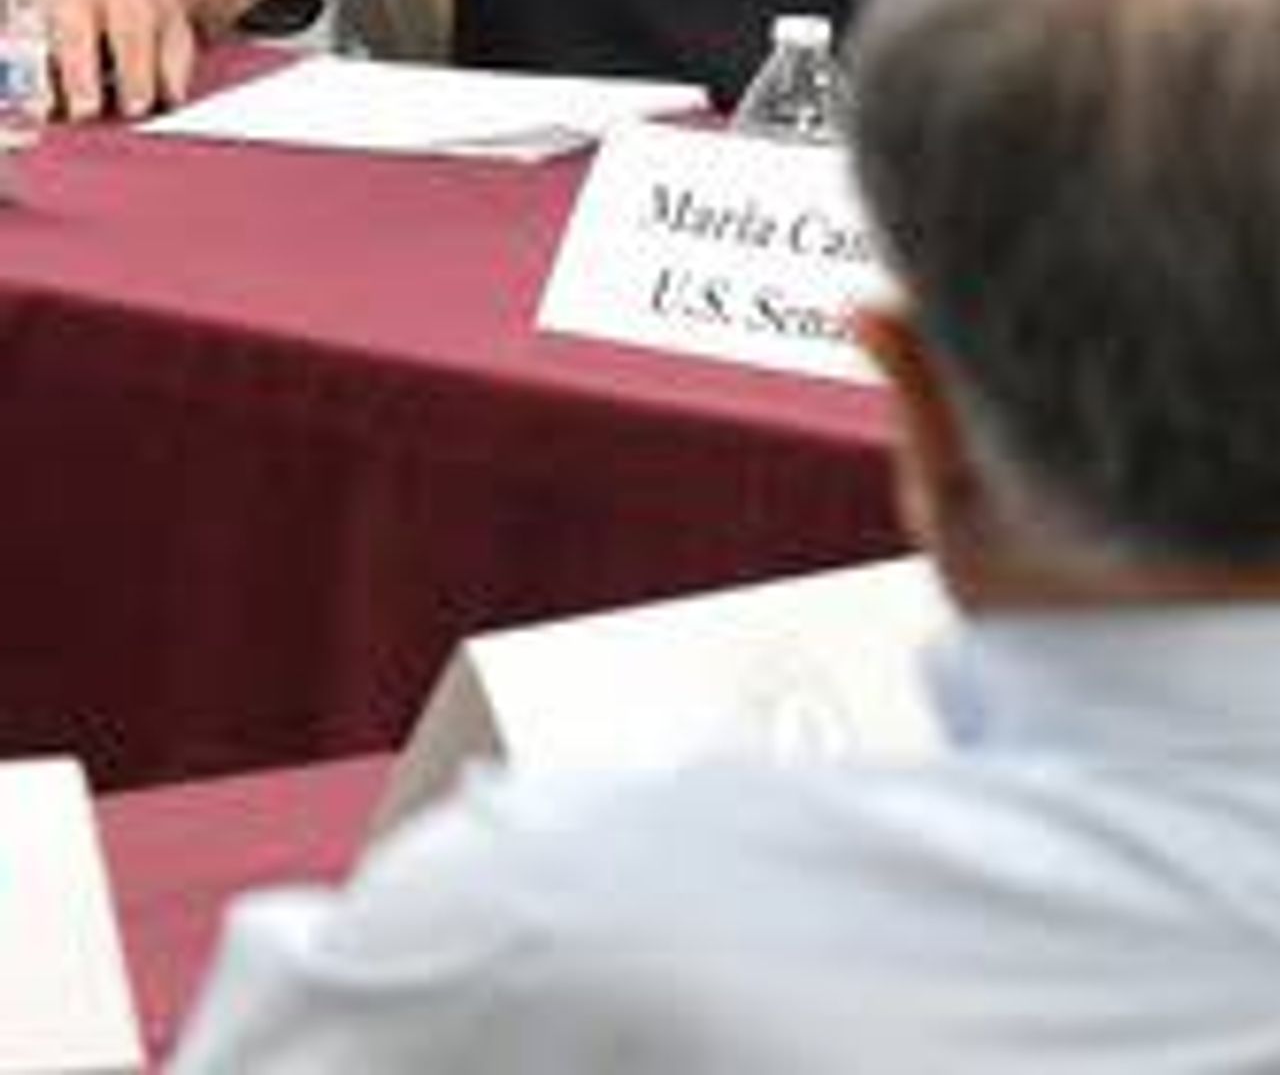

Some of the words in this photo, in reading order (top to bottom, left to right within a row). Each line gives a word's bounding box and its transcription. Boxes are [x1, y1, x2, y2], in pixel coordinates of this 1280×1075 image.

[650, 182, 778, 248] Maria
[788, 207, 882, 265] Can
[650, 268, 734, 325] U.S.
